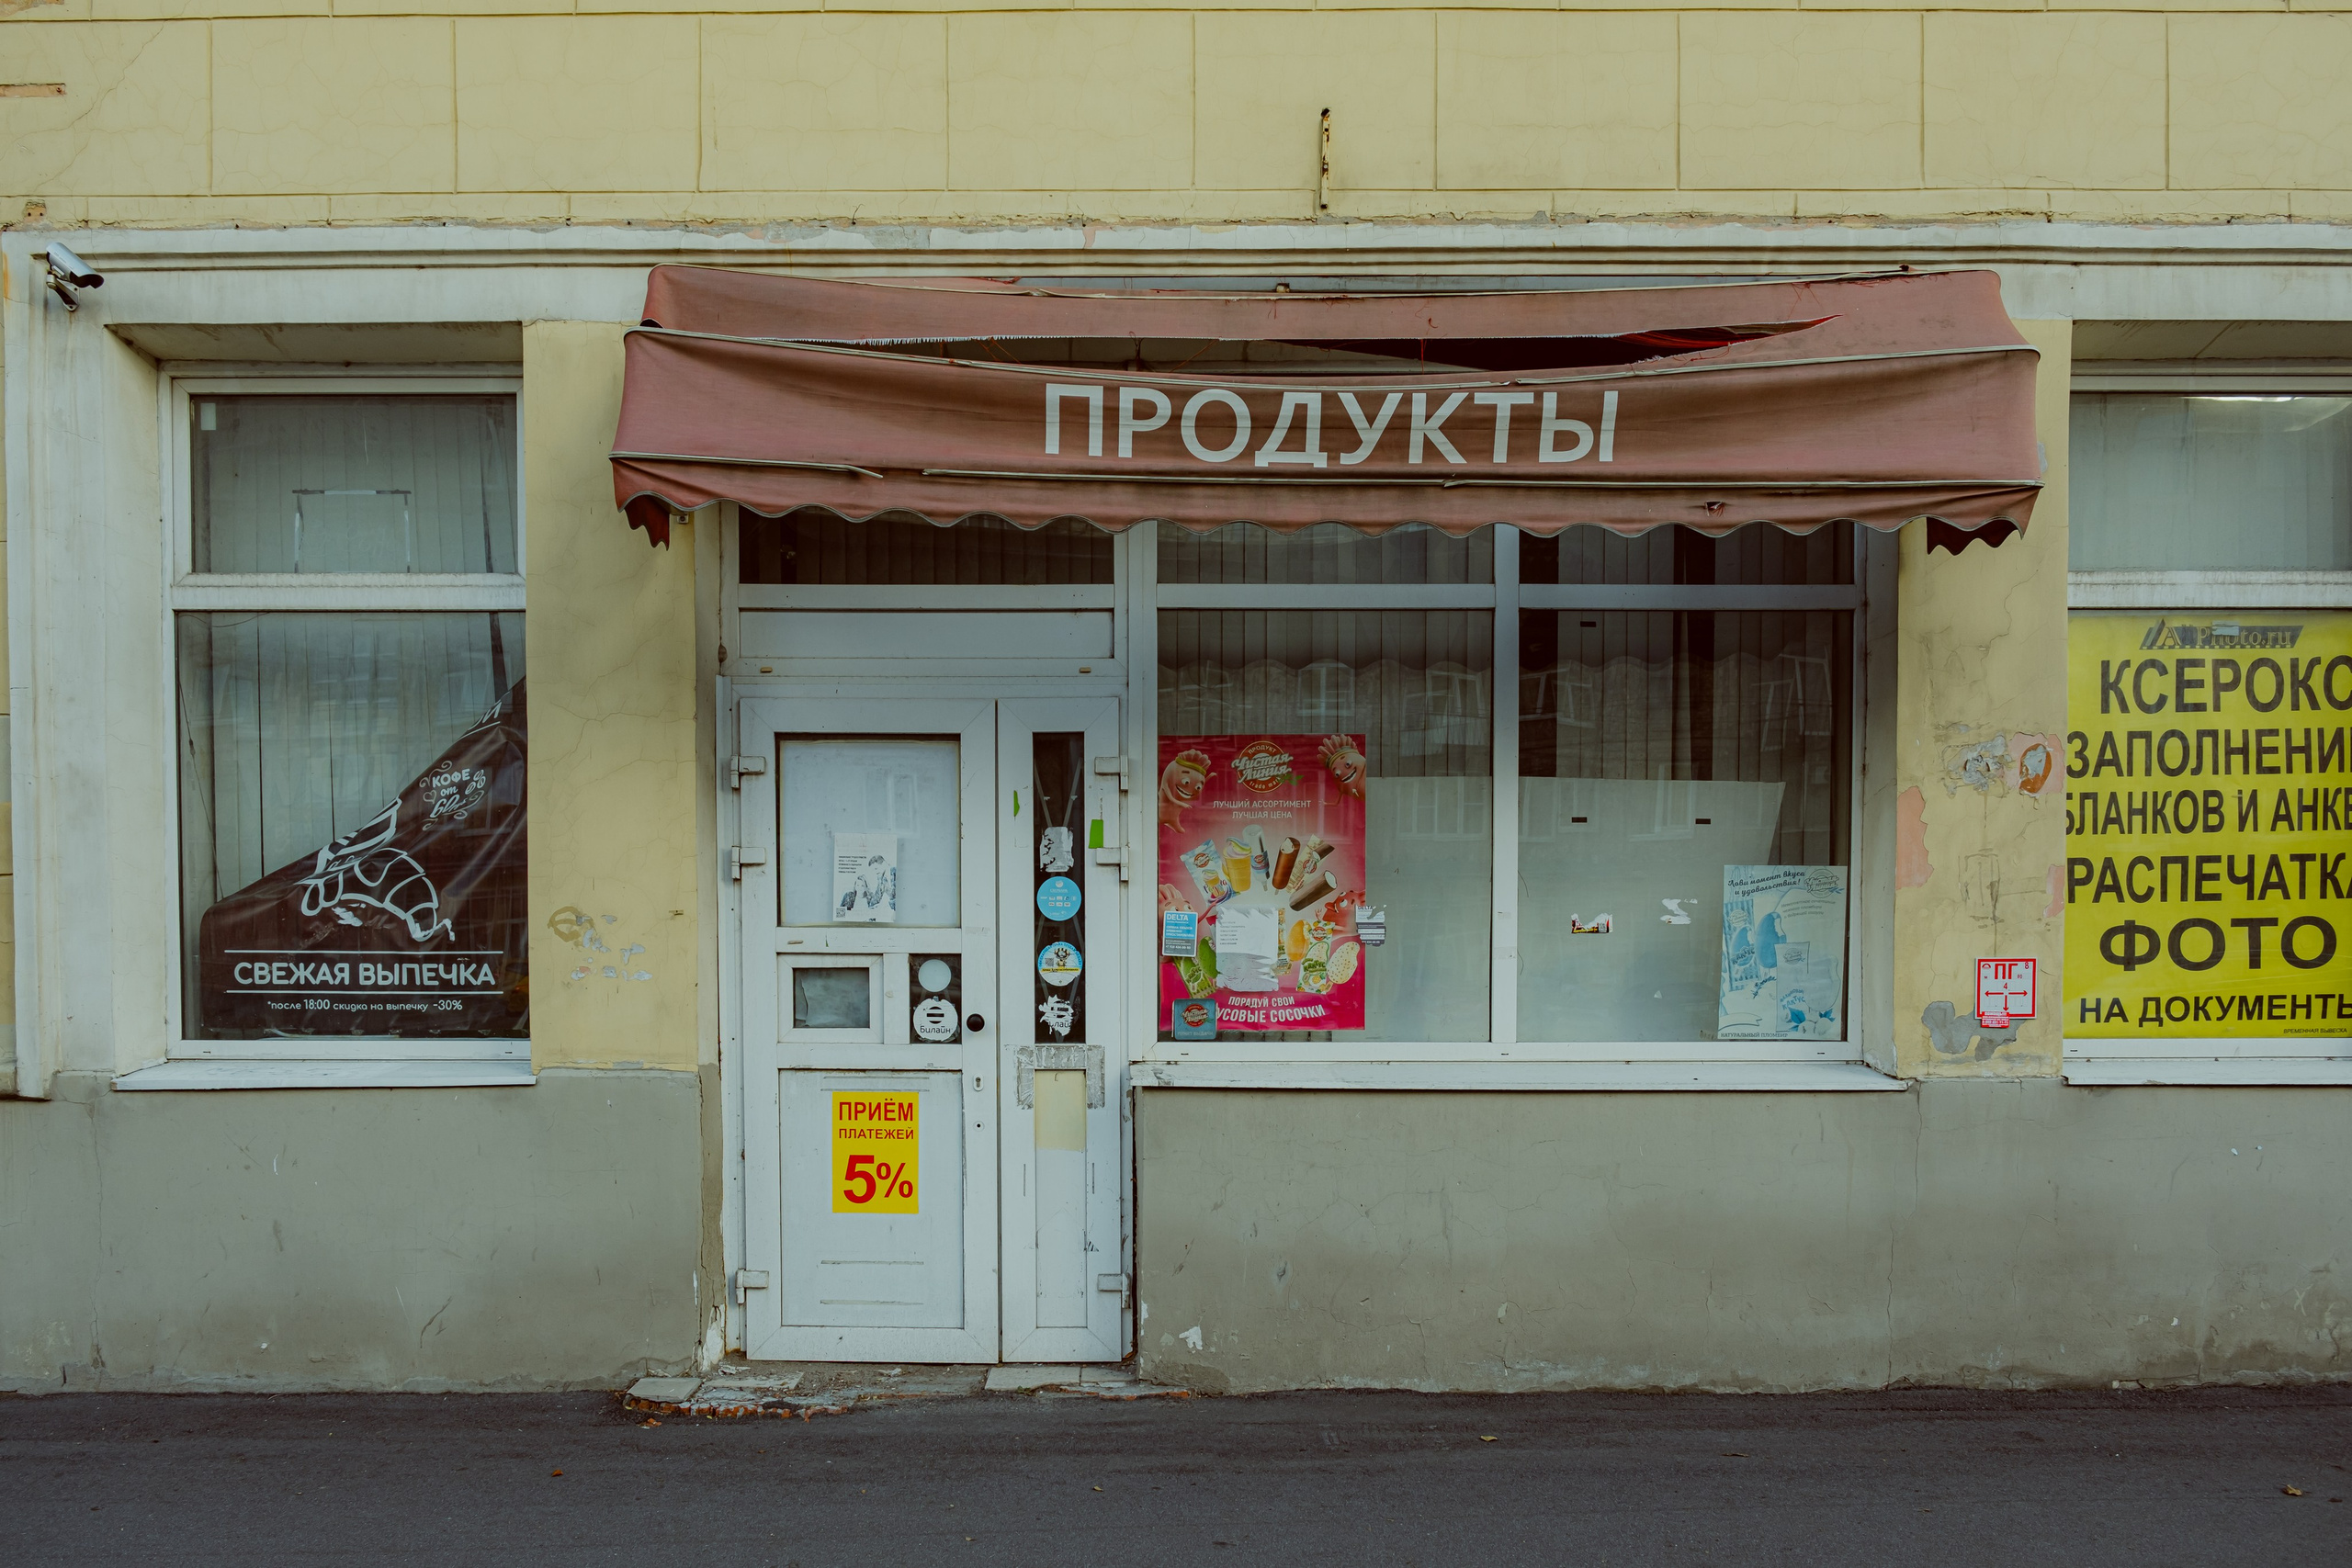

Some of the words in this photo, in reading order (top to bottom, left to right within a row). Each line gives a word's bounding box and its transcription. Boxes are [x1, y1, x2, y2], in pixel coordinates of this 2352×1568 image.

[1045, 383, 1619, 468] ПРОДУКТЫ
[2100, 654, 2352, 714] КСЕРОКС
[1248, 745, 1276, 754] ПРОДУКТ
[2066, 727, 2352, 779] ЗАПОЛНЕНИ
[1231, 752, 1294, 771] Чистая
[432, 768, 470, 788] КОФЕ
[1238, 764, 1292, 784] Линия
[440, 785, 458, 796] от
[1250, 781, 1266, 789] trade
[1213, 799, 1250, 808] ЛУЧШИЙ
[1251, 800, 1311, 808] АССОРТИМЕНТ
[2237, 789, 2257, 832] И
[1232, 811, 1268, 819] ЛУЧШАЯ
[1270, 811, 1293, 819] ЦЕНА
[1727, 880, 1748, 888] Лови
[1749, 874, 1781, 886] момент
[1782, 870, 1805, 880] вкуса
[2067, 852, 2352, 904] РАСПЕЧАТК
[1741, 879, 1801, 897] удовольствия!
[1166, 913, 1189, 921] DELTA
[2099, 915, 2337, 972] ФОТО
[233, 962, 349, 985] СВЕЖАЯ
[358, 963, 496, 986] ВЫПЕЧКА
[1995, 963, 2018, 979] ПГ
[303, 998, 330, 1010] 18:00
[333, 1002, 368, 1012] скидка
[386, 1003, 428, 1012] выпечку
[433, 999, 463, 1010] -30%
[1227, 996, 1268, 1009] ПОРАДУЙ
[1272, 996, 1295, 1007] СВОИ
[2079, 997, 2129, 1023] НА
[1216, 1007, 1266, 1022] УСОВЫЕ
[1270, 1004, 1326, 1022] СОСОЧКИ
[920, 1025, 951, 1033] Билайн
[839, 1098, 913, 1121] ПРИЁМ
[839, 1126, 914, 1140] ПЛАТЕЖЕЙ
[843, 1155, 913, 1203] 5%
